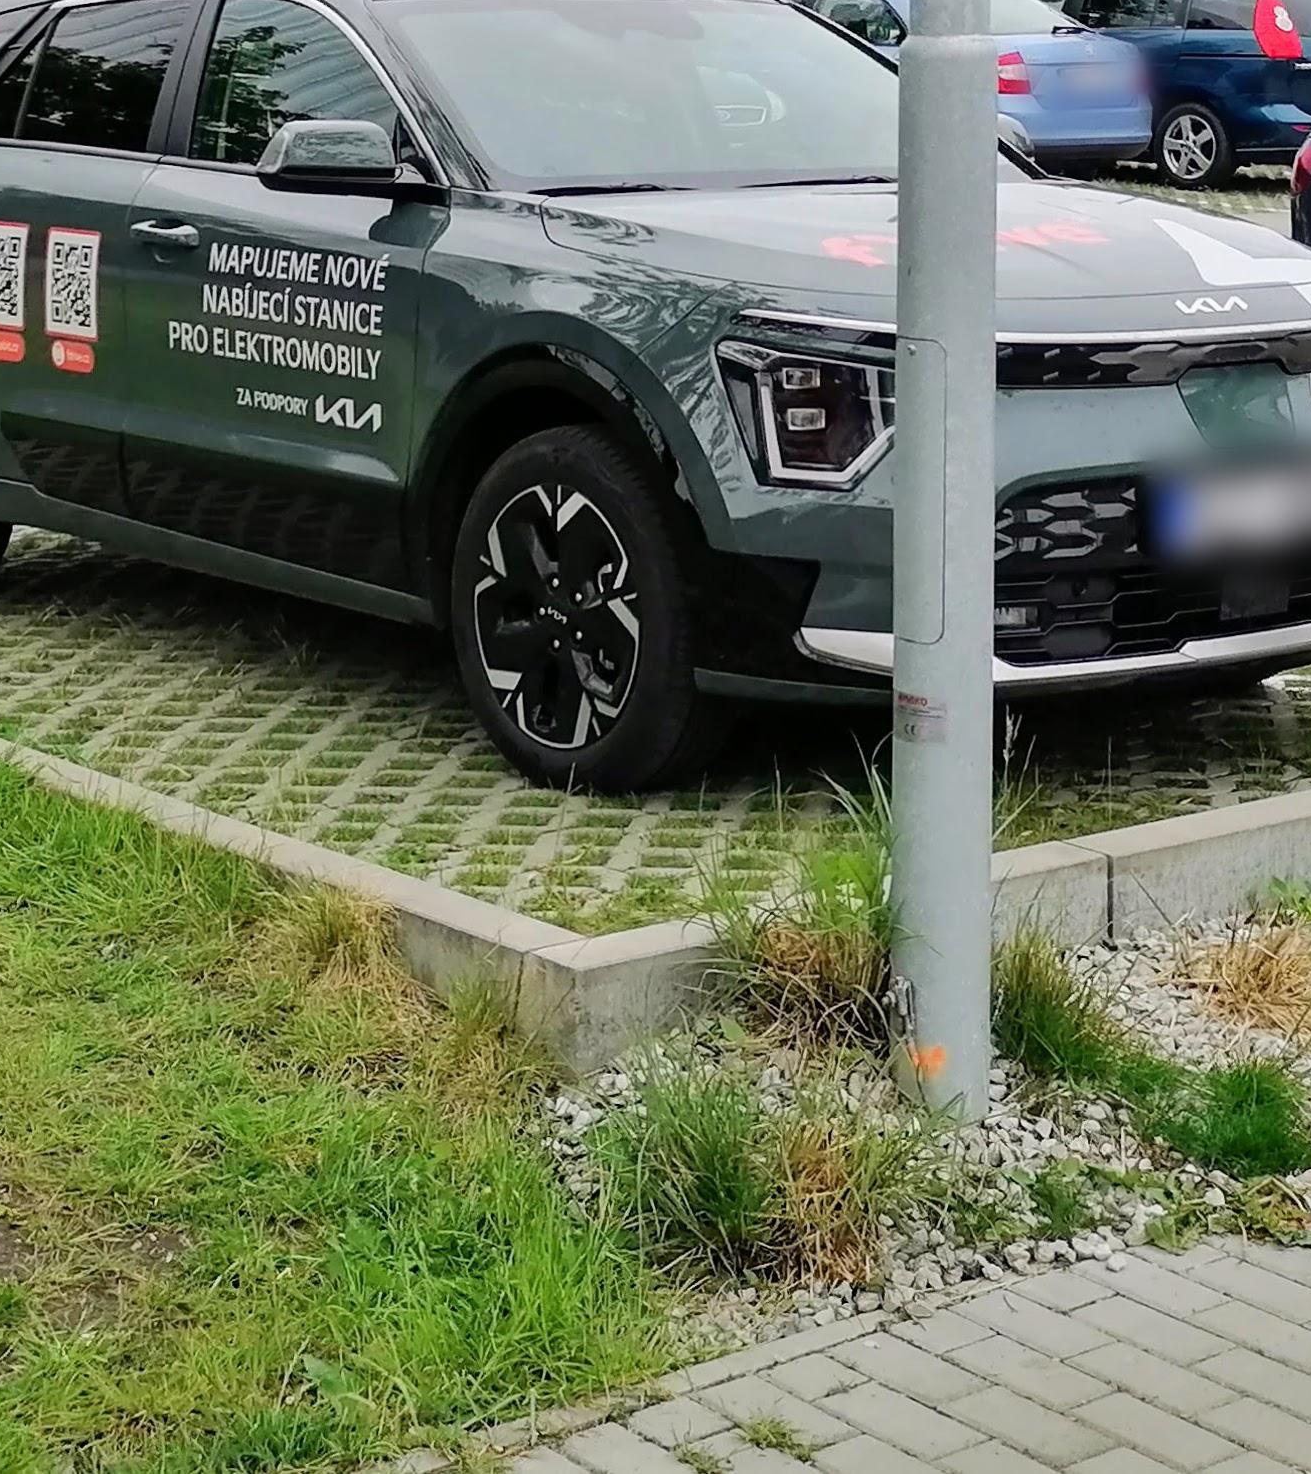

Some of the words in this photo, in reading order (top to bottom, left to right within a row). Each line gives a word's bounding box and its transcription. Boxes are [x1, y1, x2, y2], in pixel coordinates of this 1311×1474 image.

[208, 242, 322, 283] MAPUJEME
[324, 253, 390, 291] NOVÉ
[202, 282, 292, 324] NABÍJECÍ
[294, 294, 384, 336] STANICE
[168, 320, 209, 354] PRO
[212, 327, 382, 380] ELEKTROMOBILY
[236, 387, 252, 406] ZA
[253, 390, 309, 416] PODPORY
[315, 394, 382, 433] KIA
